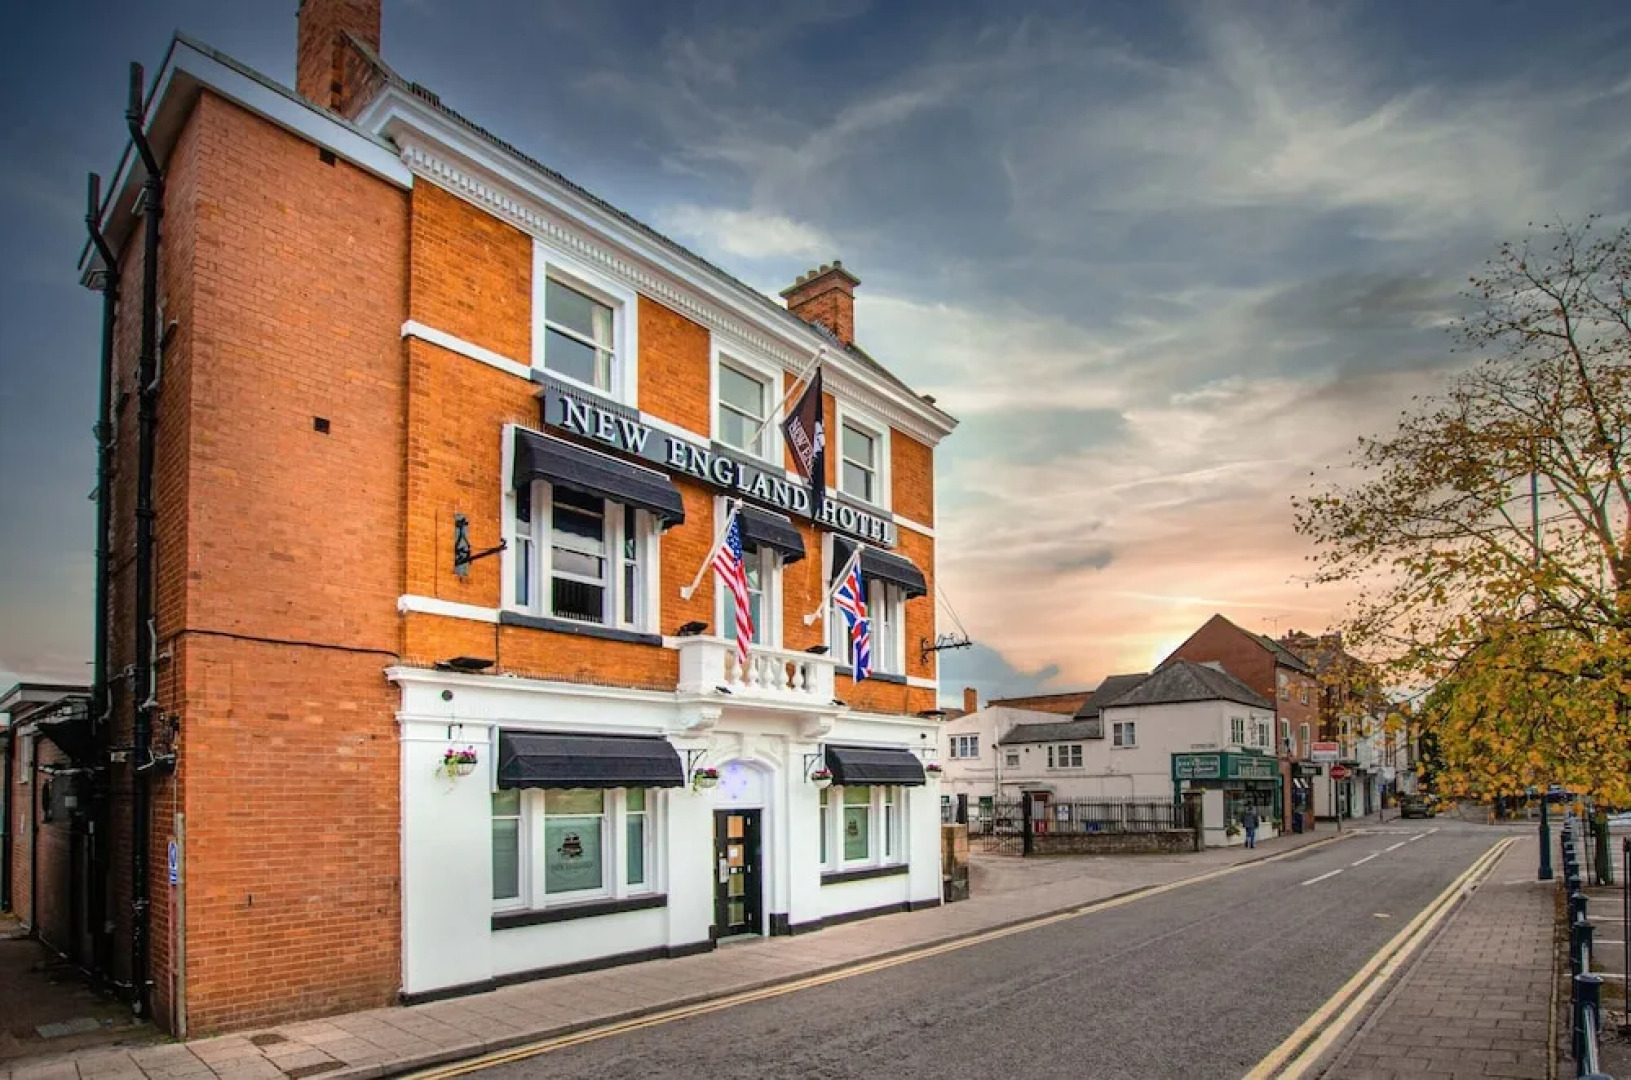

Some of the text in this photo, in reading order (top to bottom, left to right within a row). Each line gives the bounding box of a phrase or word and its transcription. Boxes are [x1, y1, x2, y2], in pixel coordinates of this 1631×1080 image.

[562, 396, 652, 454] NEW
[668, 437, 808, 511] ENGLAND
[822, 498, 893, 543] HOTEL
